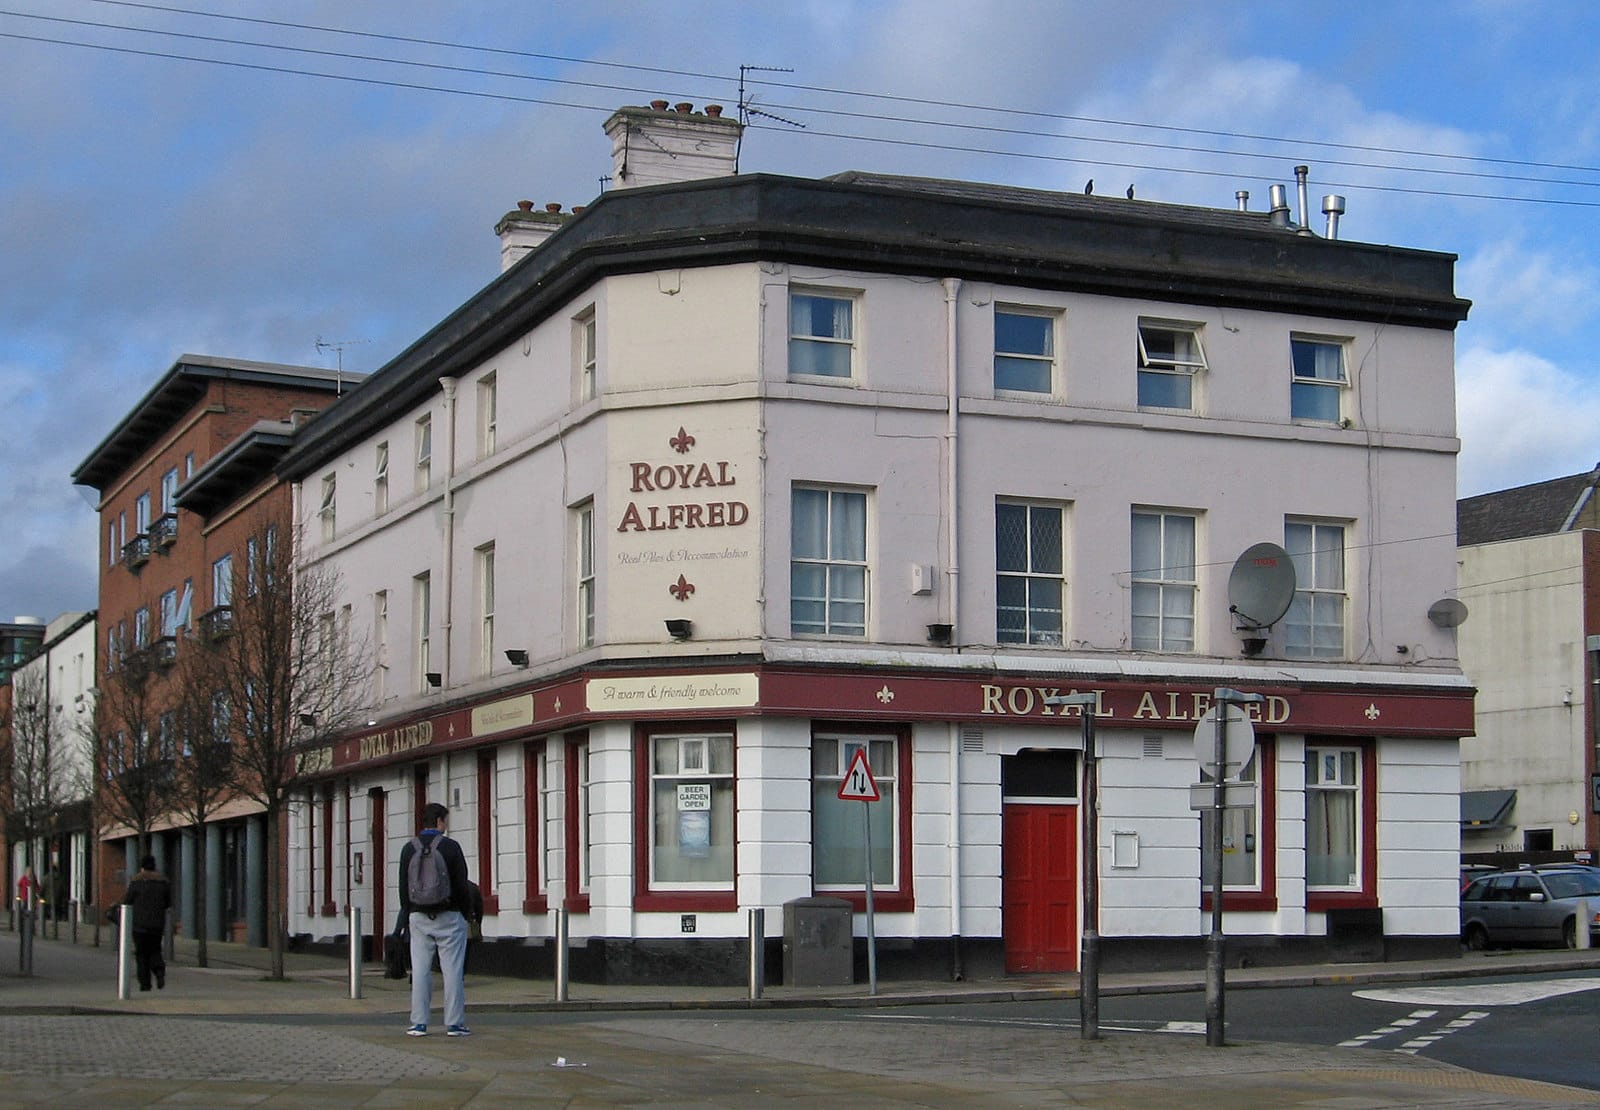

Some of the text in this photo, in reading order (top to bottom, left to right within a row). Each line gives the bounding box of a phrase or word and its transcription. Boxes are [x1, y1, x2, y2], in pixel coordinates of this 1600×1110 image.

[630, 462, 736, 492] ROYAL
[617, 501, 749, 532] ALFRED
[603, 683, 741, 701] A warm & friendly welcome
[981, 685, 1290, 723] ROYAL ALFED
